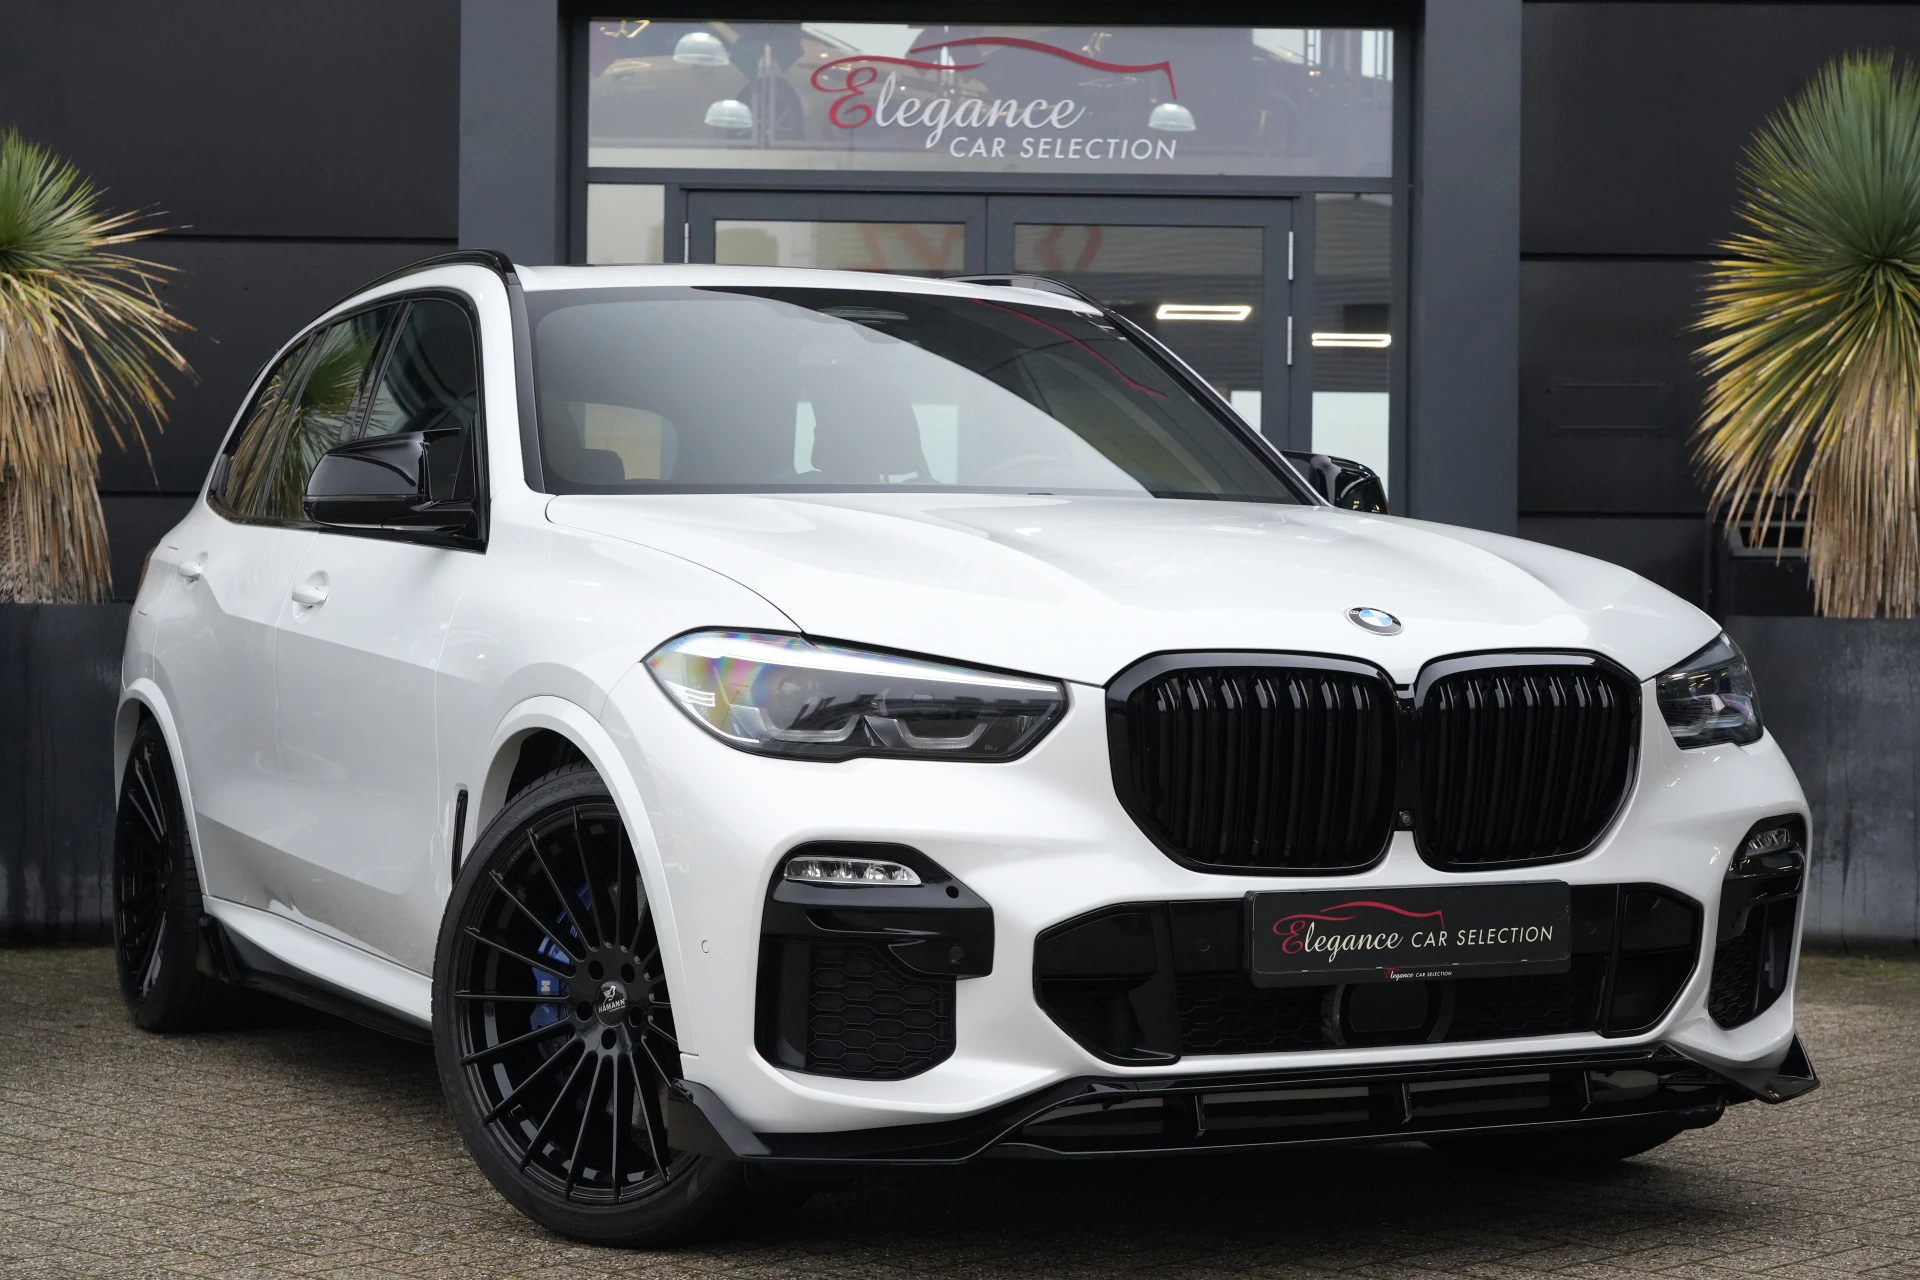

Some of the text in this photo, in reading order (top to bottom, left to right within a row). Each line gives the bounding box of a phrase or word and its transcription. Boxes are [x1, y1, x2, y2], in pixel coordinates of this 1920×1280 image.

[810, 55, 1086, 149] Elegance
[949, 136, 1177, 160] CAR SELECTION
[1273, 914, 1553, 963] Elegance CAR SELECTION
[598, 999, 626, 1013] HAMANN
